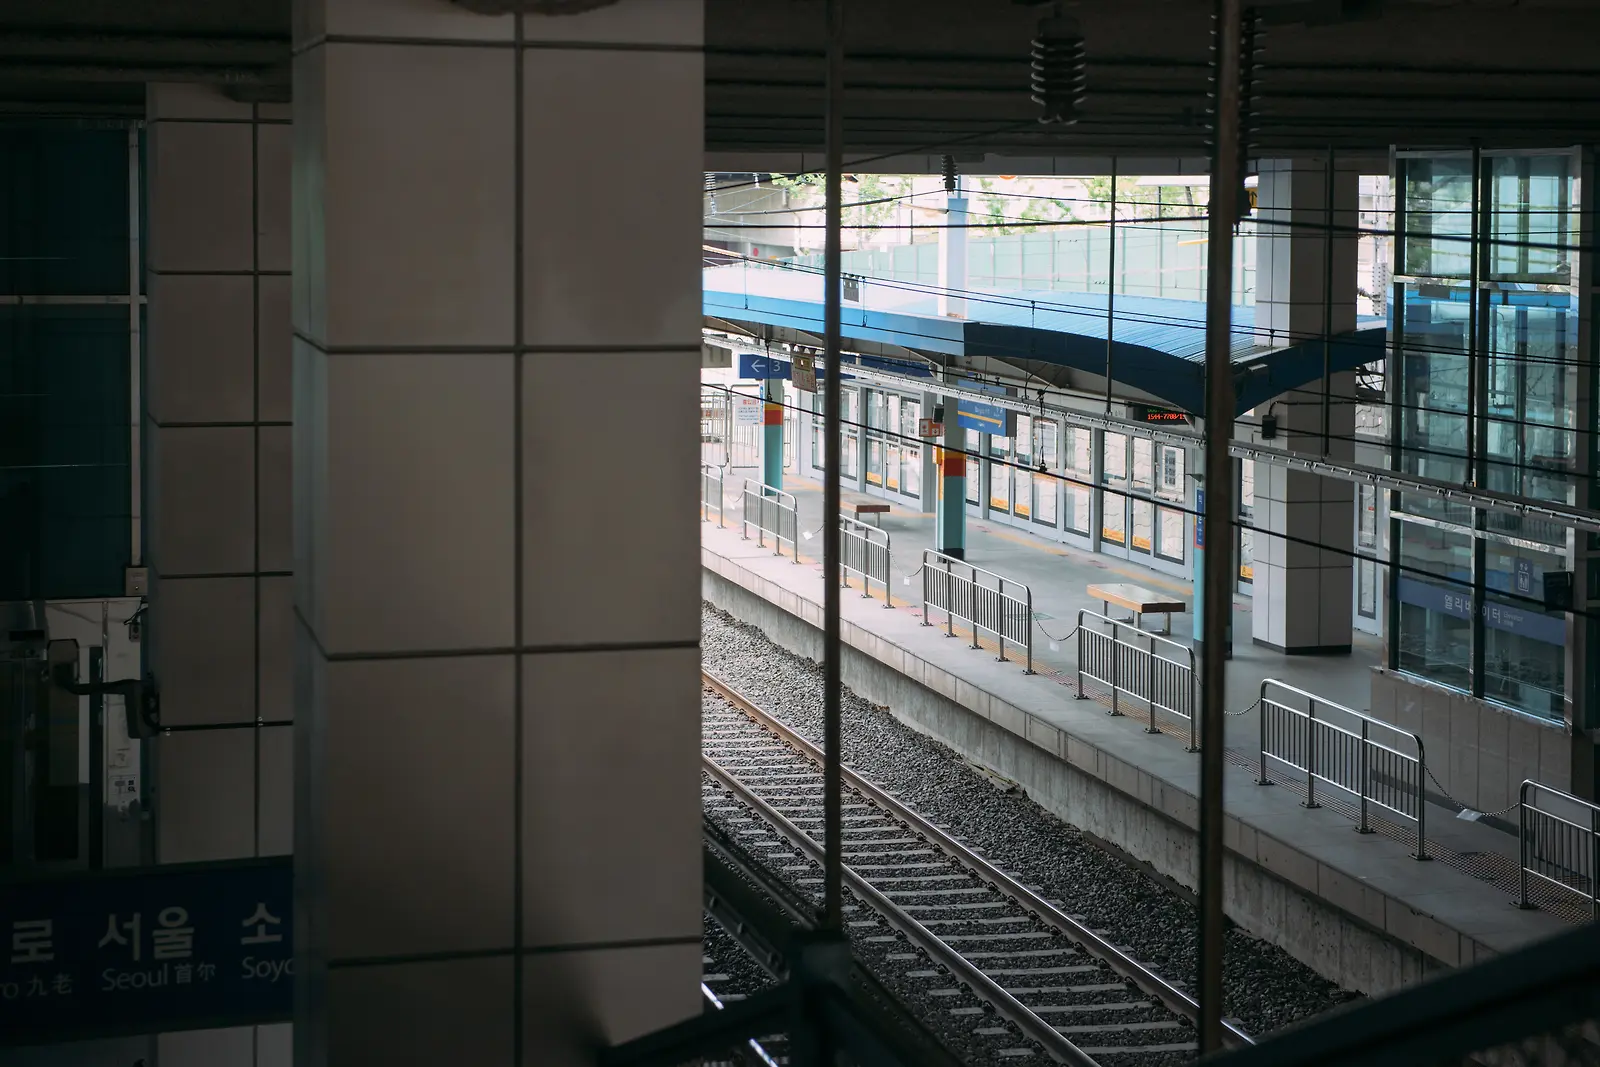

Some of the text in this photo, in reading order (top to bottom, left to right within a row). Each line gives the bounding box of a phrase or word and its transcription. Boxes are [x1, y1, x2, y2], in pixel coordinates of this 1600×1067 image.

[773, 360, 781, 372] 3
[10, 902, 283, 964] 로 서울 소
[26, 972, 74, 998] 九老
[101, 963, 168, 991] Seoul
[174, 962, 216, 985] 首尔
